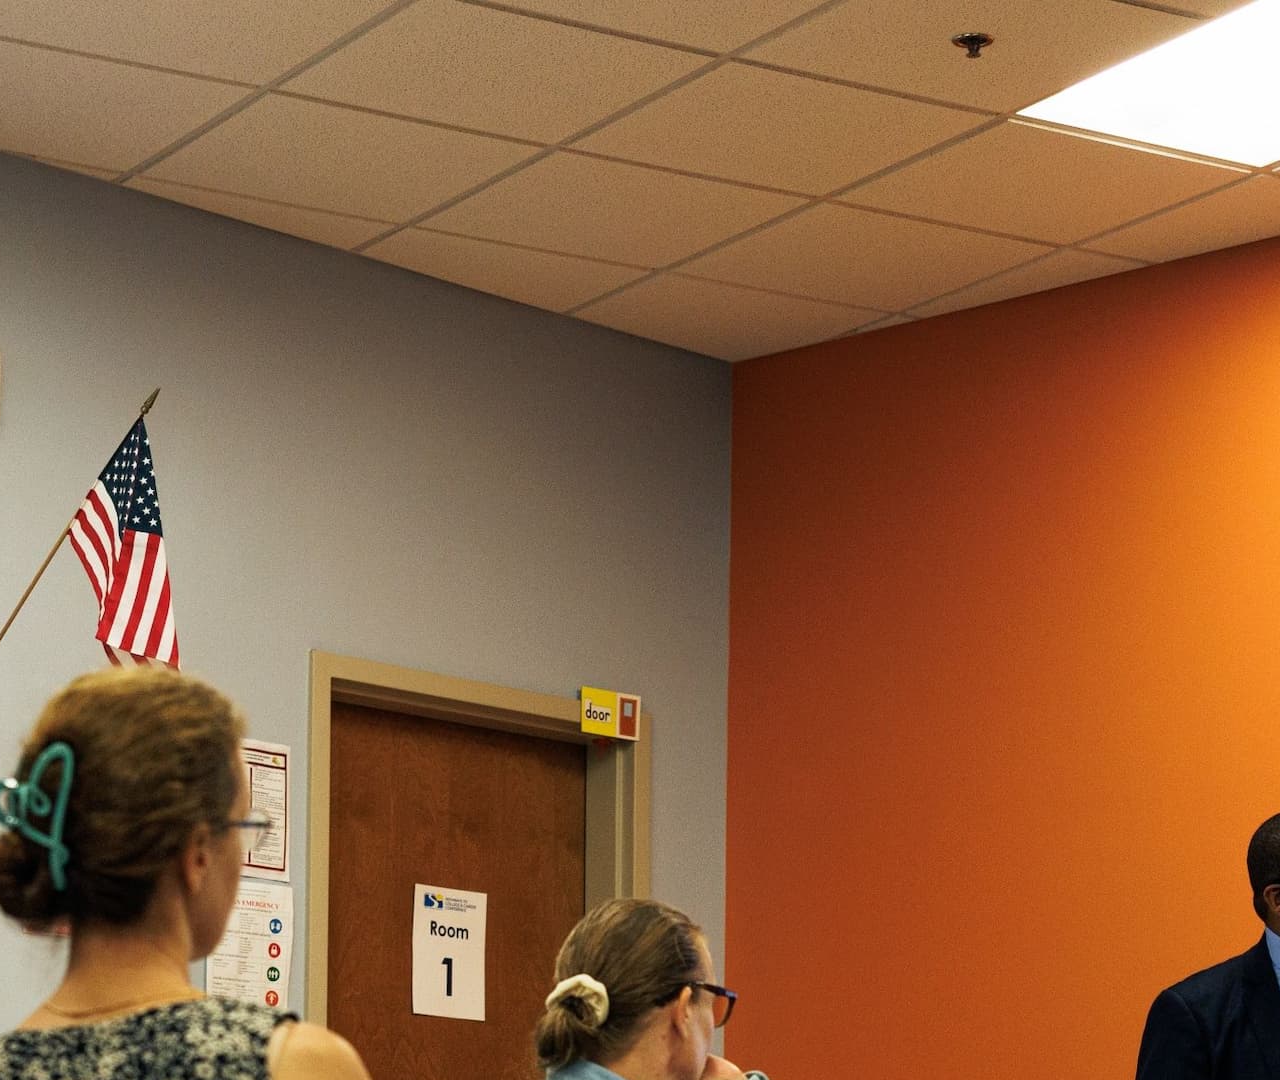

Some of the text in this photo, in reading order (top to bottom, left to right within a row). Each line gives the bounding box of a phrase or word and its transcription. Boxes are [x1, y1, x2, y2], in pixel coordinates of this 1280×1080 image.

[585, 702, 610, 721] door
[430, 920, 469, 940] Room
[442, 957, 453, 997] 1
